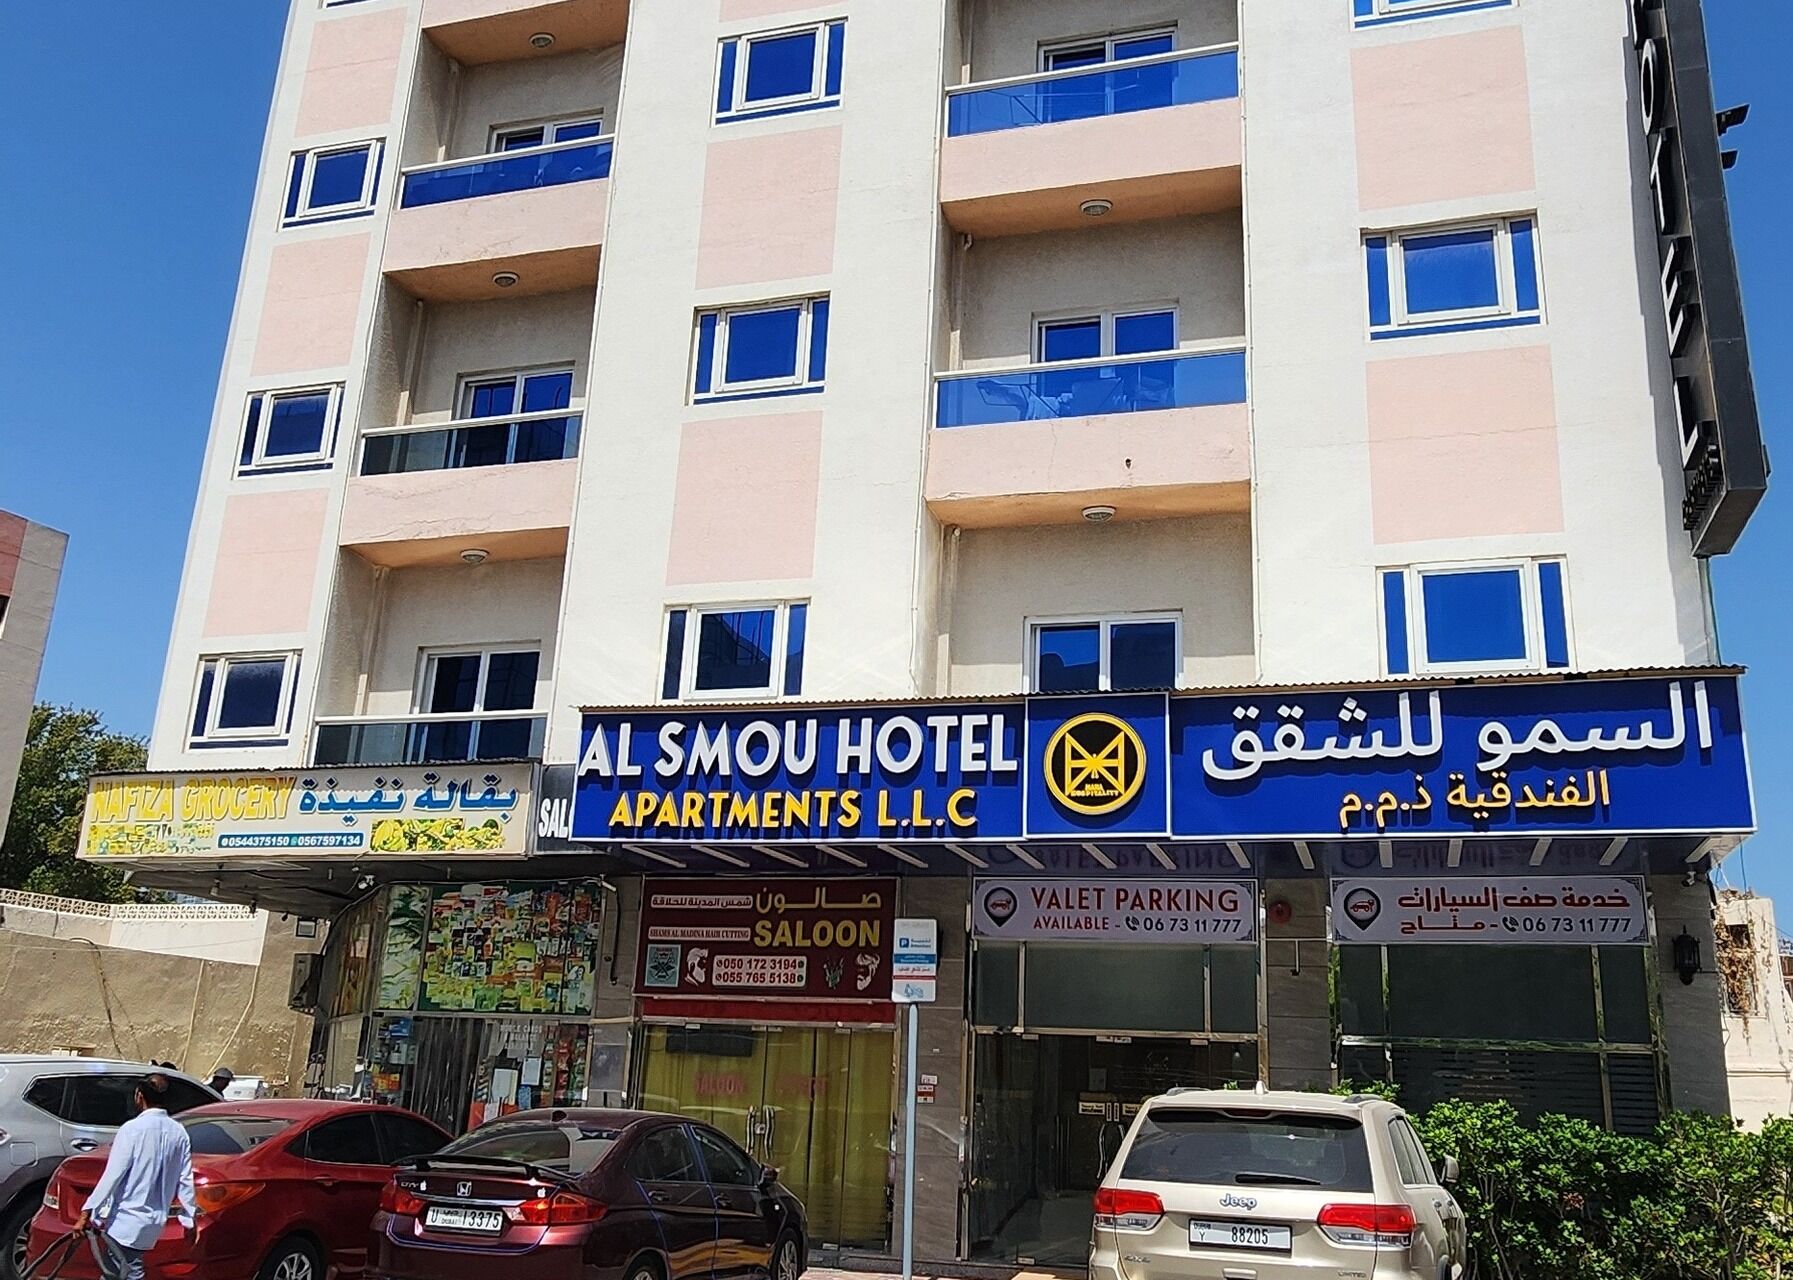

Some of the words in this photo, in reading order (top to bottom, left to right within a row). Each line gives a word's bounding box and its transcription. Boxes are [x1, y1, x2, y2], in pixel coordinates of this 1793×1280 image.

[1202, 690, 1443, 780] للشقق
[1477, 681, 1712, 771] السمو
[578, 722, 642, 777] AL
[654, 719, 817, 777] SMOU
[837, 714, 1018, 774] HOTEL
[91, 779, 175, 823] NAFIZA
[182, 775, 297, 821] GROCERY
[299, 775, 405, 826] نفيذة
[413, 771, 519, 824] بقالة
[1339, 773, 1432, 828] ذ.م.م
[1446, 768, 1610, 819] الفندقية
[608, 789, 861, 827] APARTMENTS
[877, 788, 978, 827] L.L.C
[228, 836, 289, 847] 0544375150
[297, 834, 361, 847] 0567597134
[755, 886, 882, 914] صالون
[1031, 887, 1106, 910] VALET
[1114, 888, 1239, 913] PARKING
[1398, 886, 1499, 912] السيارات
[1502, 886, 1557, 908] صف
[1561, 886, 1631, 908] خدمة
[721, 929, 749, 939] CUTTING
[754, 919, 880, 948] SALOON
[1033, 915, 1109, 930] AVAILABLE
[1143, 917, 1164, 932] 06
[1170, 918, 1189, 932] 73
[1194, 919, 1207, 933] 11
[1212, 919, 1242, 933] 777
[1401, 915, 1485, 935] متاح
[1522, 917, 1546, 932] 06
[1551, 917, 1574, 932] 73
[1579, 918, 1595, 932] 11
[1599, 918, 1632, 933] 777
[722, 958, 746, 970] 050
[747, 958, 767, 970] 172
[769, 958, 797, 970] 3194
[721, 972, 742, 984] 055
[745, 972, 767, 984] 765
[769, 972, 797, 984] 5138
[1220, 1194, 1257, 1210] Jeep
[431, 1209, 440, 1224] U
[463, 1211, 501, 1229] 13375
[1199, 1231, 1206, 1242] Y
[1231, 1226, 1269, 1245] 88205
